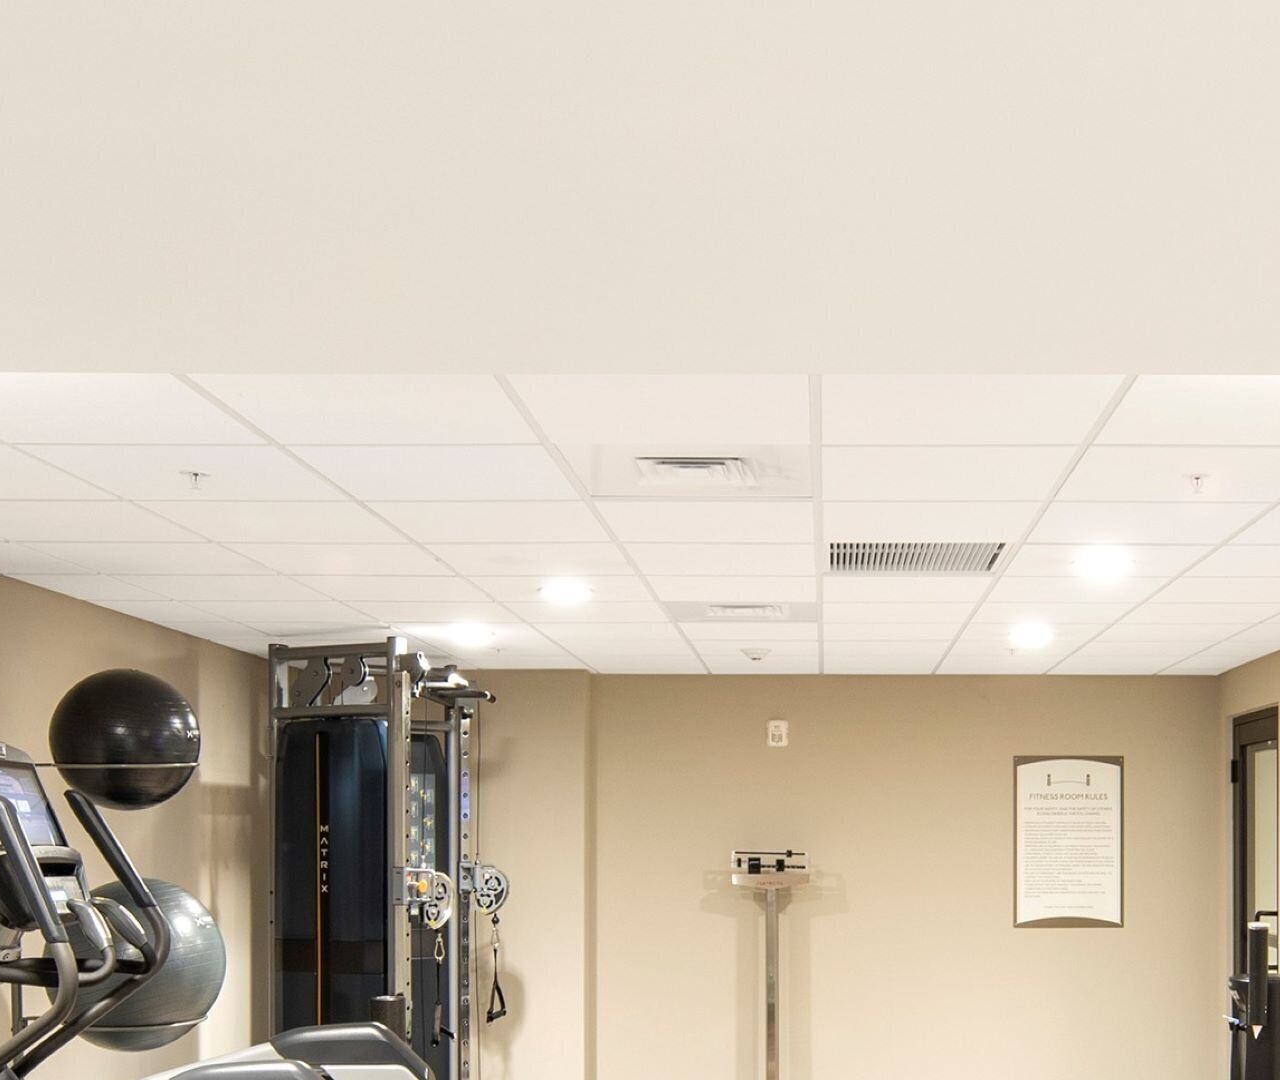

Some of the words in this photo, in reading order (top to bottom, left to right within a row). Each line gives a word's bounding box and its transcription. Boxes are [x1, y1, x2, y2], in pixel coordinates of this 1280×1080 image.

[1029, 793, 1059, 801] FITNESS
[1060, 793, 1084, 801] ROOM
[1085, 793, 1108, 801] RULES
[320, 824, 329, 893] MATRIX
